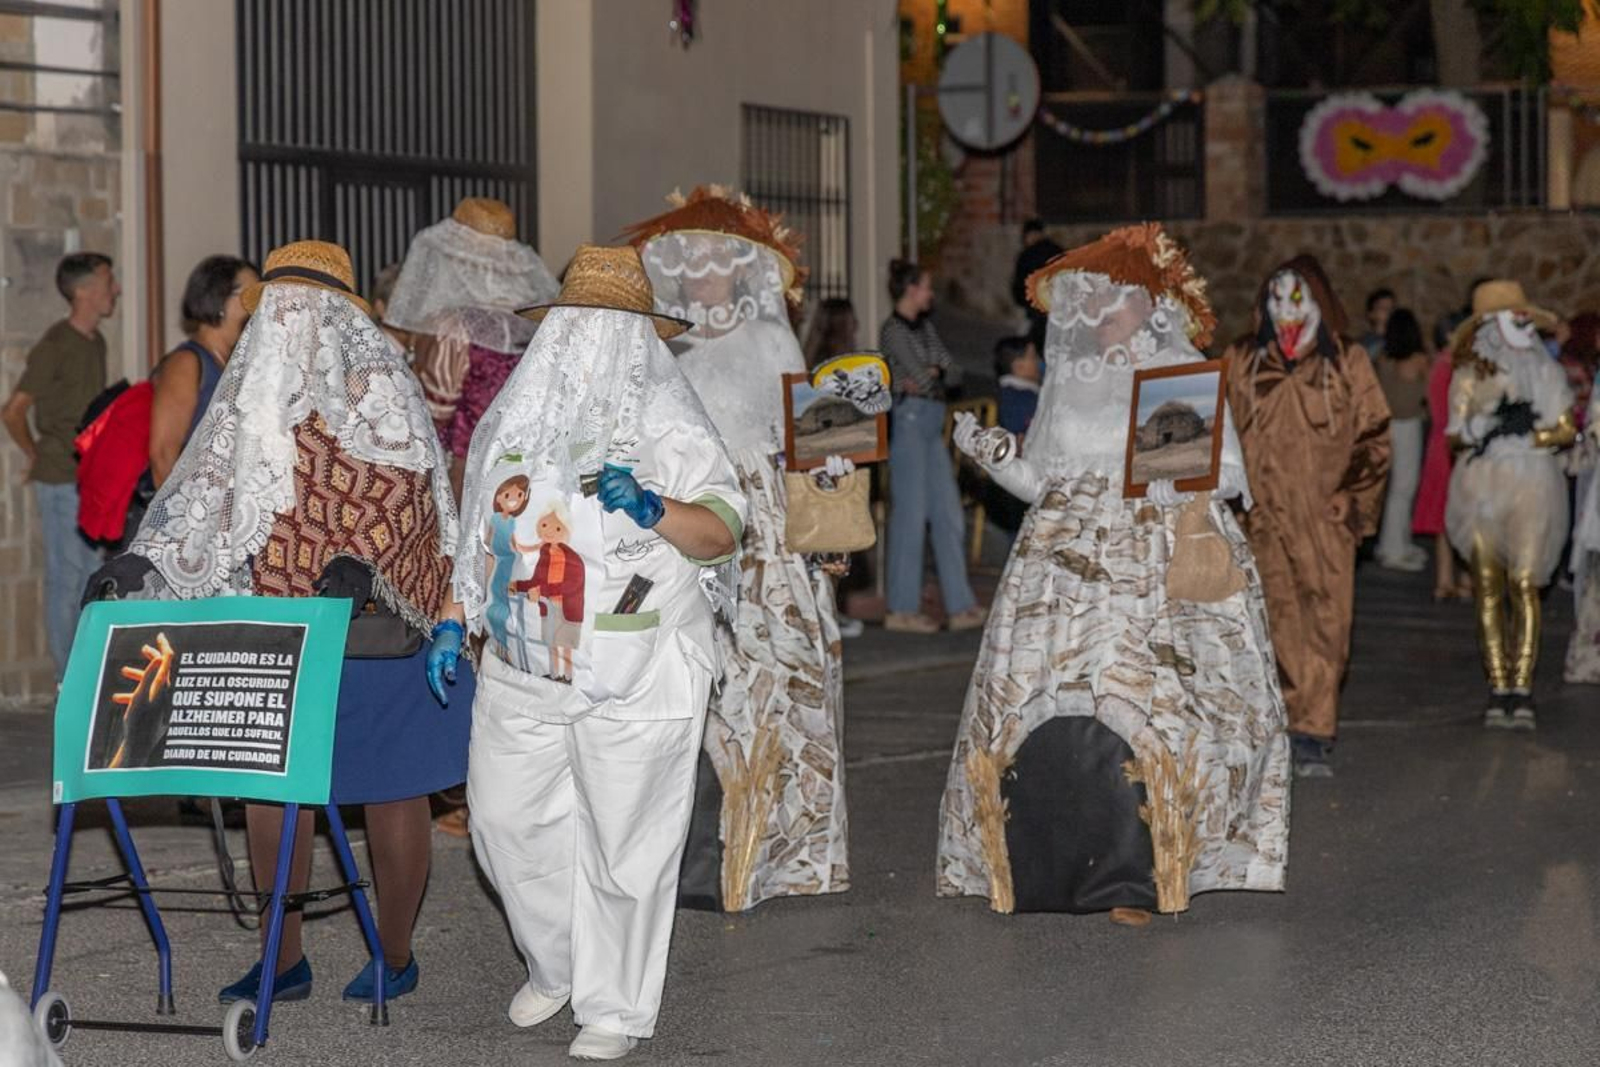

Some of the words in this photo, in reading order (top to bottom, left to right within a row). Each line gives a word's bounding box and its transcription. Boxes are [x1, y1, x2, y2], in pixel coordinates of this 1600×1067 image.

[180, 653, 194, 664] EL
[197, 652, 258, 665] CUIDADOR
[260, 653, 275, 665] ES
[277, 654, 292, 666] LA
[176, 677, 194, 687] LUZ
[197, 677, 211, 687] EN
[212, 677, 225, 687] LA
[227, 677, 289, 689] OSCURIDAD
[173, 691, 202, 706] QUE
[204, 692, 265, 707] SUPONE
[267, 693, 286, 708] EL
[170, 709, 245, 724] ALZHEIMER
[247, 711, 284, 726] PARA
[167, 727, 210, 736] AQUELLOS
[212, 728, 230, 737] QUE
[231, 728, 243, 737] LO
[244, 729, 283, 740] SUFREN.
[164, 749, 195, 759] DIARIO
[197, 749, 210, 759] DE
[212, 750, 226, 760] UN
[228, 751, 280, 764] CUIDADOR
